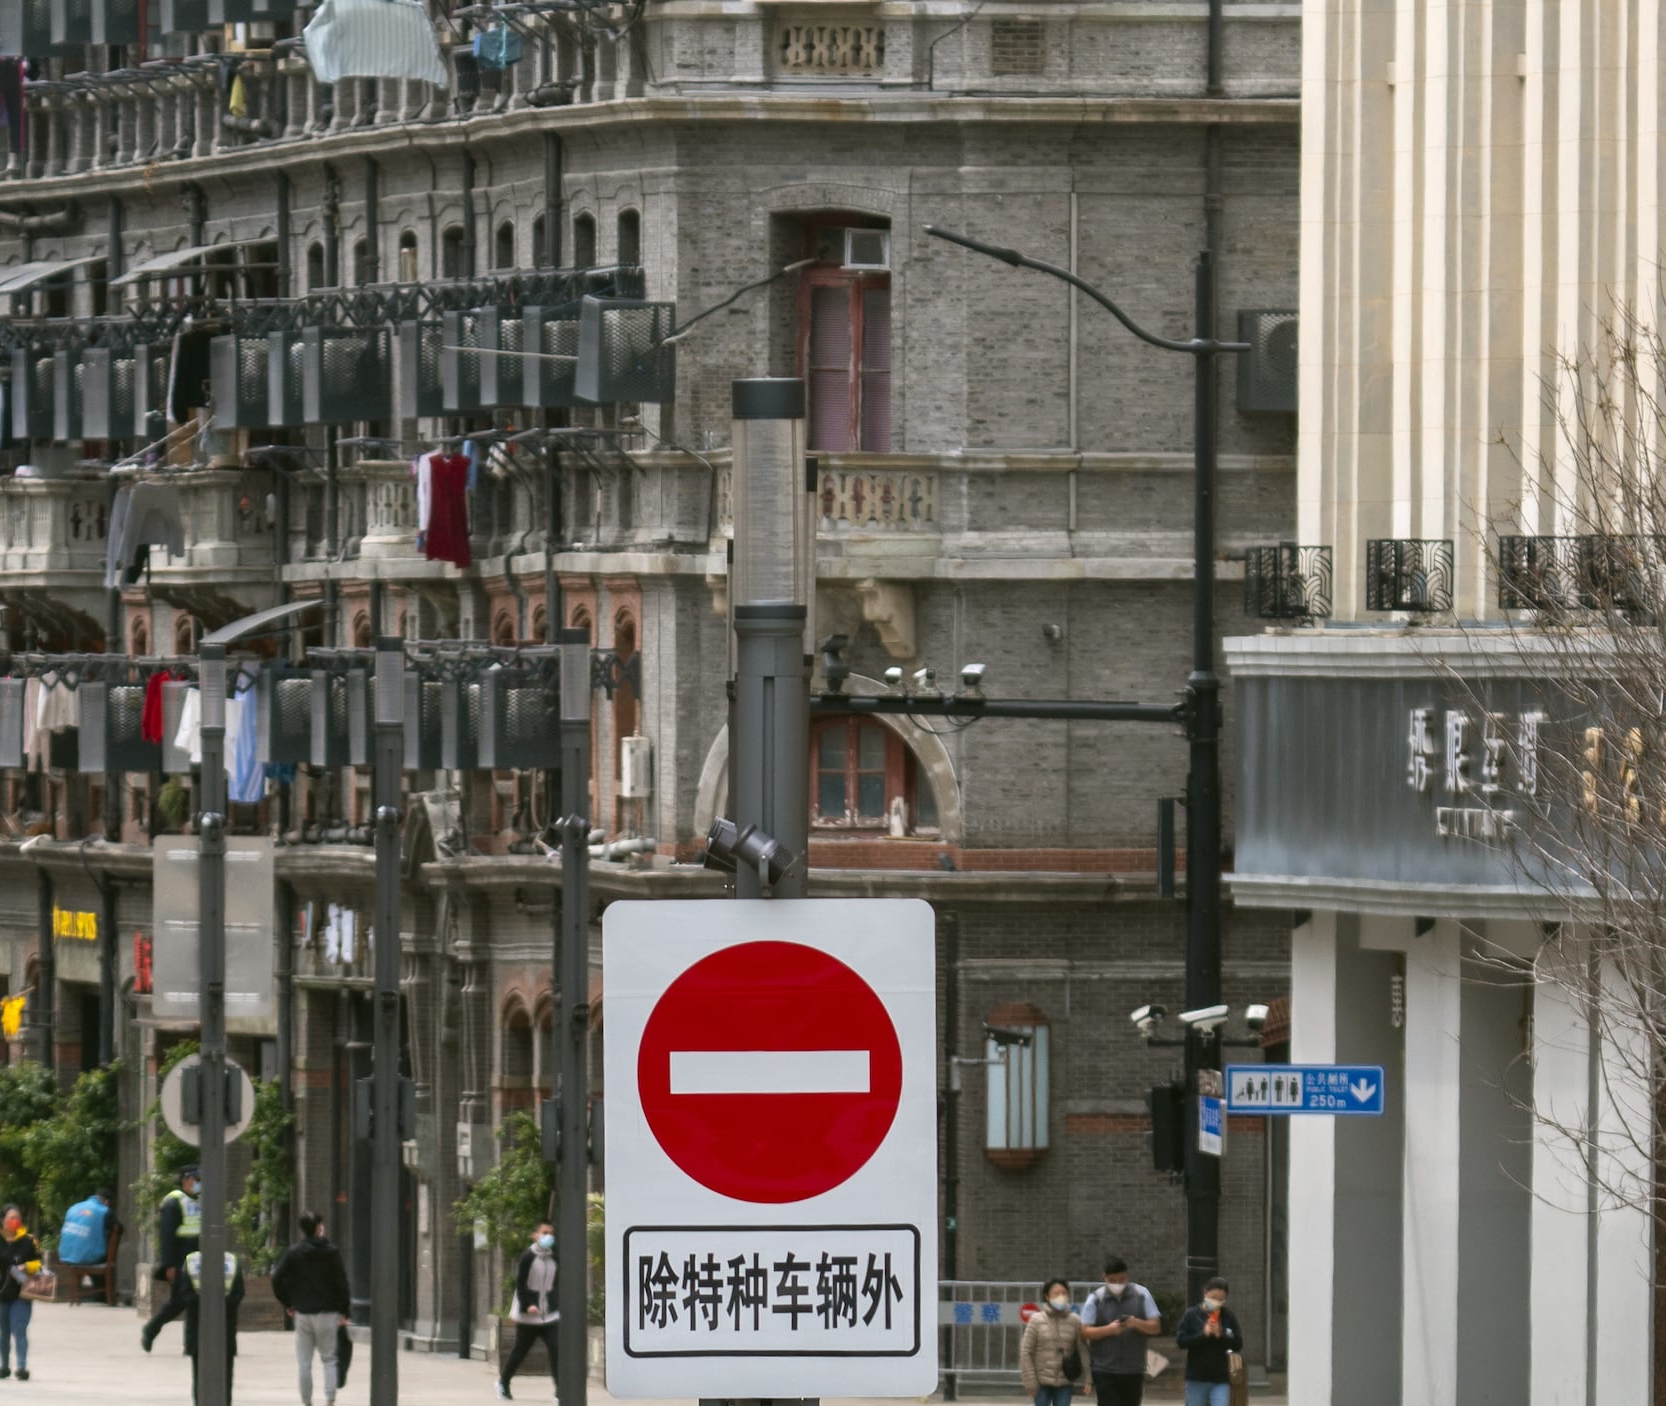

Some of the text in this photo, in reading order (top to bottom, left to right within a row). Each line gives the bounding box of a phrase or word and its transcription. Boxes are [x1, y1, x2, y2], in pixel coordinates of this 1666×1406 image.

[1305, 1073, 1349, 1086] 公共厕所
[1309, 1095, 1347, 1108] 250m
[638, 1251, 904, 1331] 除特种车辆外
